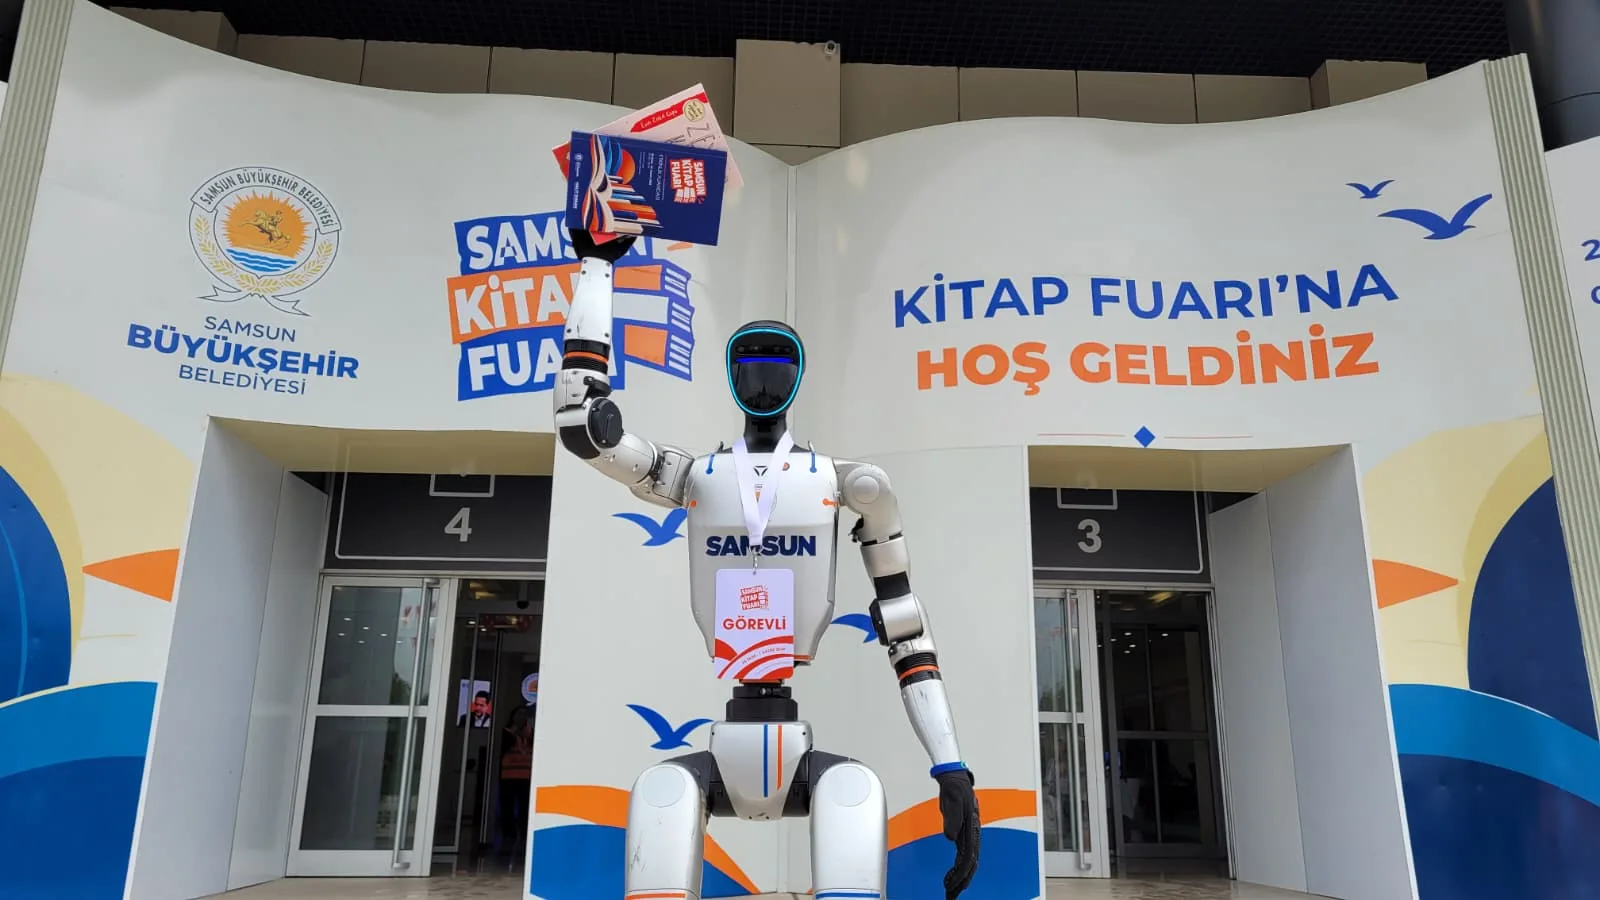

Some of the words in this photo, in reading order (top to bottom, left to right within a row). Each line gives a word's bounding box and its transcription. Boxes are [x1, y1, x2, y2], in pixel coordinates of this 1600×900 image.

[671, 161, 682, 188] FUARI
[682, 159, 694, 187] KİTAP
[694, 161, 706, 196] SAMSUN
[200, 175, 237, 205] SAMSUN
[237, 168, 299, 192] BÜYÜKŞEHİR
[298, 186, 339, 228] BELEDİYESİ
[454, 272, 580, 336] KİTA
[894, 272, 1069, 328] KİTAP
[1091, 263, 1399, 321] FUARI'NA
[204, 315, 297, 343] SAMSUN
[127, 323, 360, 379] BÜYÜKŞEHİR
[916, 341, 1051, 397] HOŞ
[1069, 323, 1380, 387] GELDİNİZ
[179, 364, 306, 395] BELEDİYESİ
[444, 507, 472, 542] 4
[1077, 518, 1102, 553] 3
[722, 615, 786, 631] GÖREVLİ
